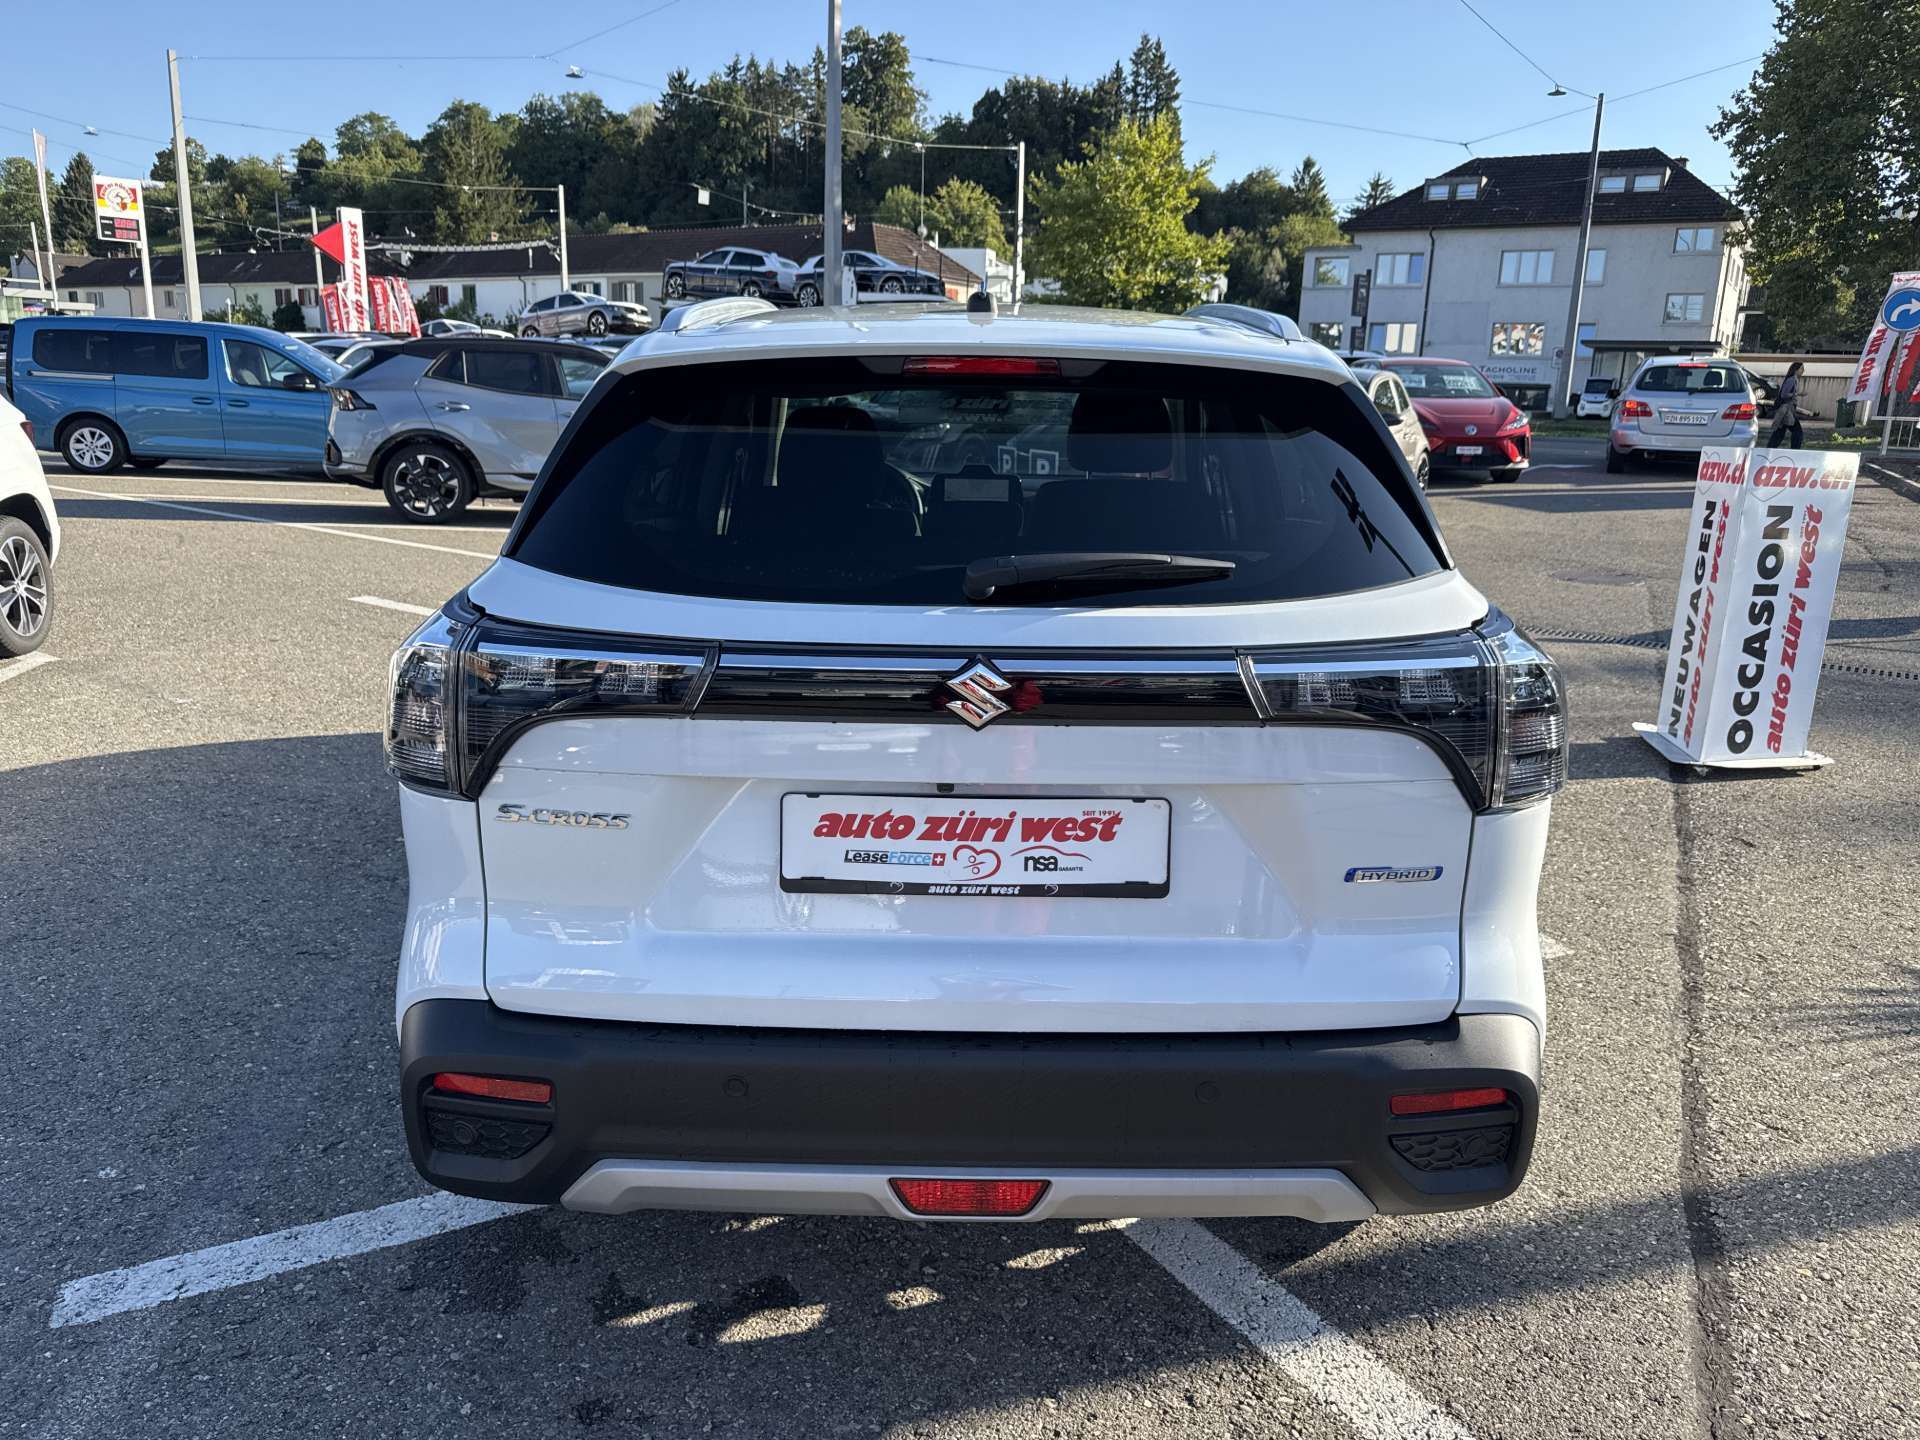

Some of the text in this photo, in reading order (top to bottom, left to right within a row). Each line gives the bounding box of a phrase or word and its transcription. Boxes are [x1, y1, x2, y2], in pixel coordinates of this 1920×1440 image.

[348, 220, 360, 260] west
[1700, 453, 1747, 485] azw.ch
[1753, 464, 1852, 490] azw.ch
[1668, 500, 1717, 738] NEUWAGEN
[1684, 498, 1729, 748] auto züri west
[1726, 505, 1794, 755] OCCASION
[1767, 503, 1823, 754] auto züri west
[813, 809, 1123, 843] auto züri west
[844, 849, 931, 864] LeaseForce
[1024, 855, 1058, 872] nsa
[928, 884, 1020, 895] auto züri west
[1361, 871, 1429, 880] HYBRID
